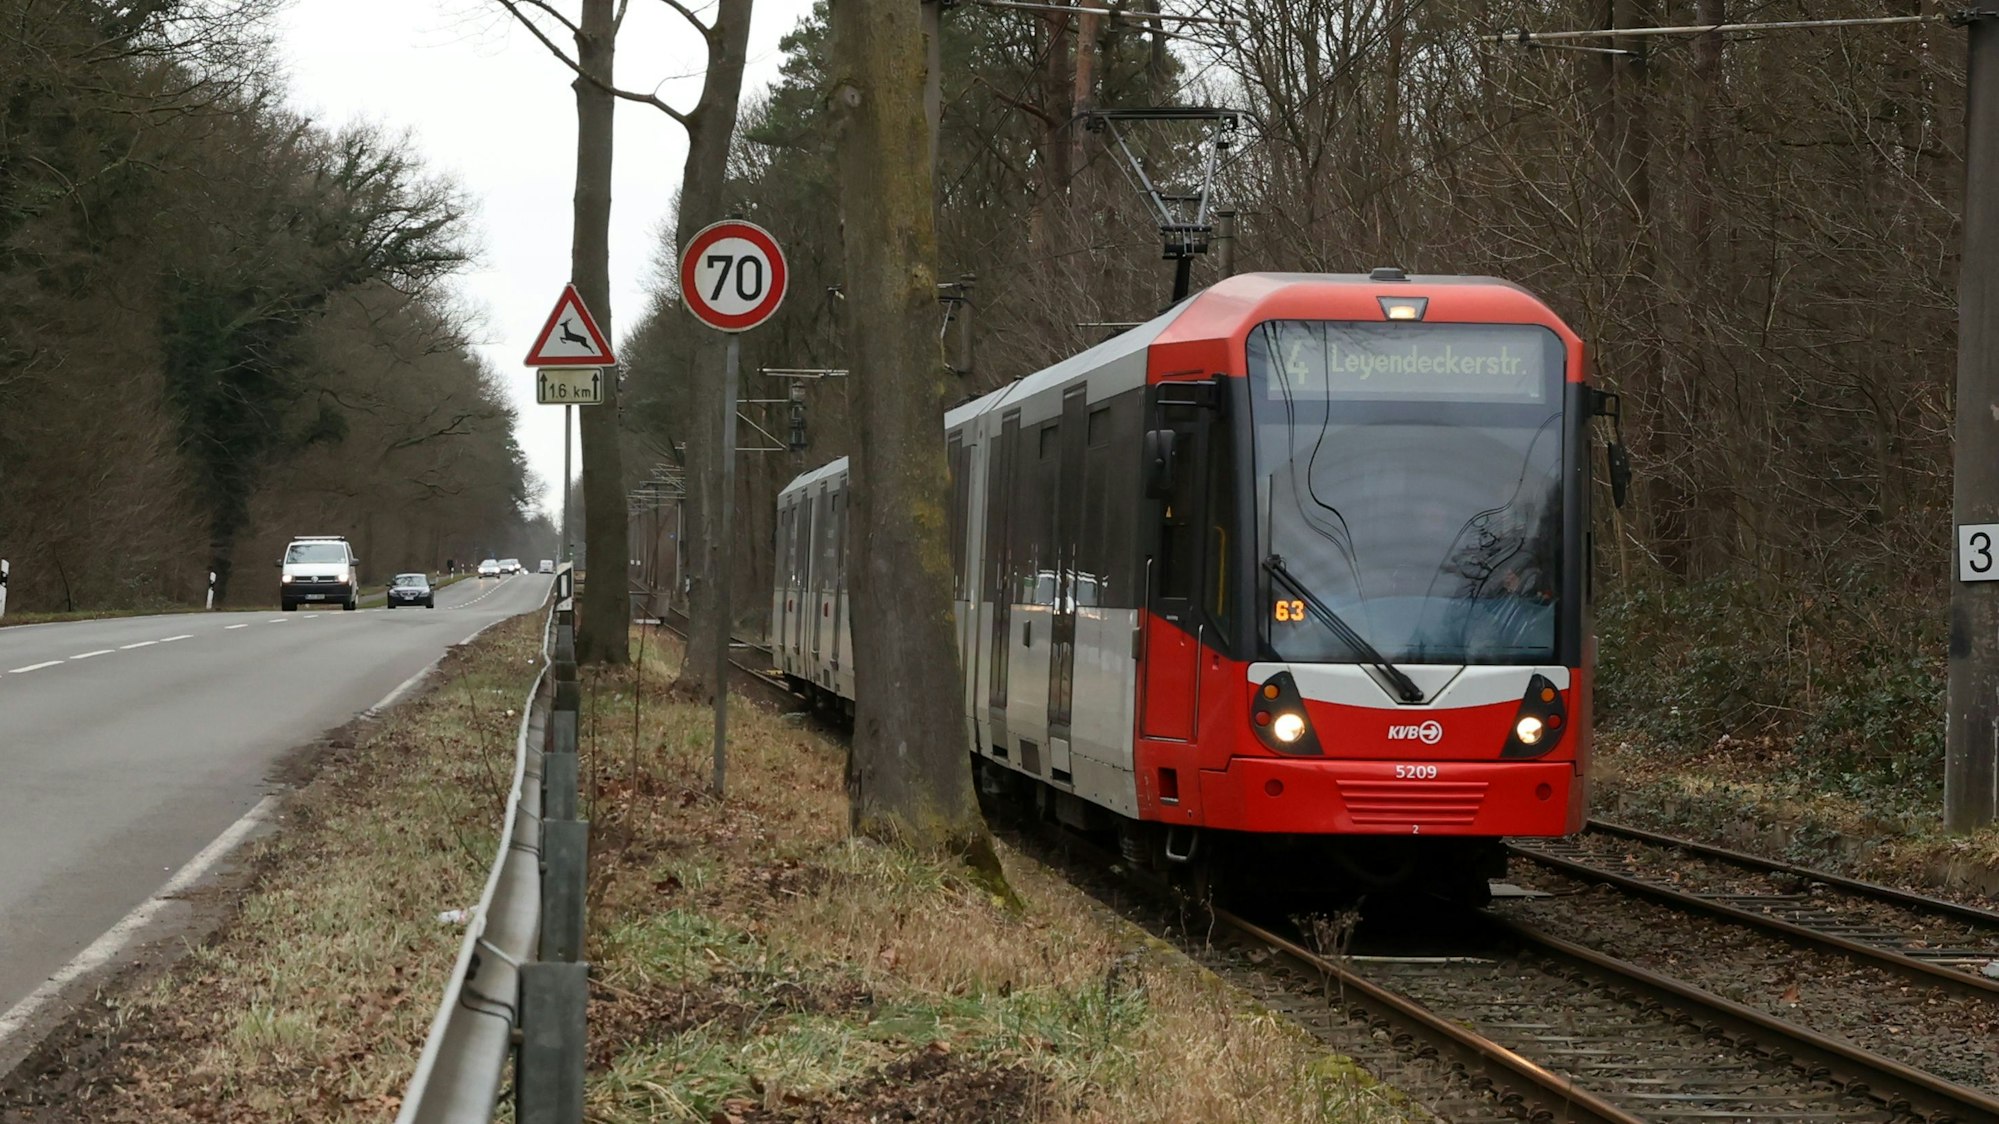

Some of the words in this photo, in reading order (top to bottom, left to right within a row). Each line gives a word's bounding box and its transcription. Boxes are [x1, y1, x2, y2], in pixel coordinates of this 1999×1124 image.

[707, 254, 762, 301] 70
[1287, 342, 1309, 384] 4
[1331, 343, 1527, 380] Leyendeckerstr.
[573, 385, 591, 398] km
[1969, 532, 1993, 573] 3
[1275, 600, 1304, 621] 63
[1387, 725, 1419, 740] KVB
[1395, 765, 1437, 779] 5209
[1412, 824, 1419, 835] 2
